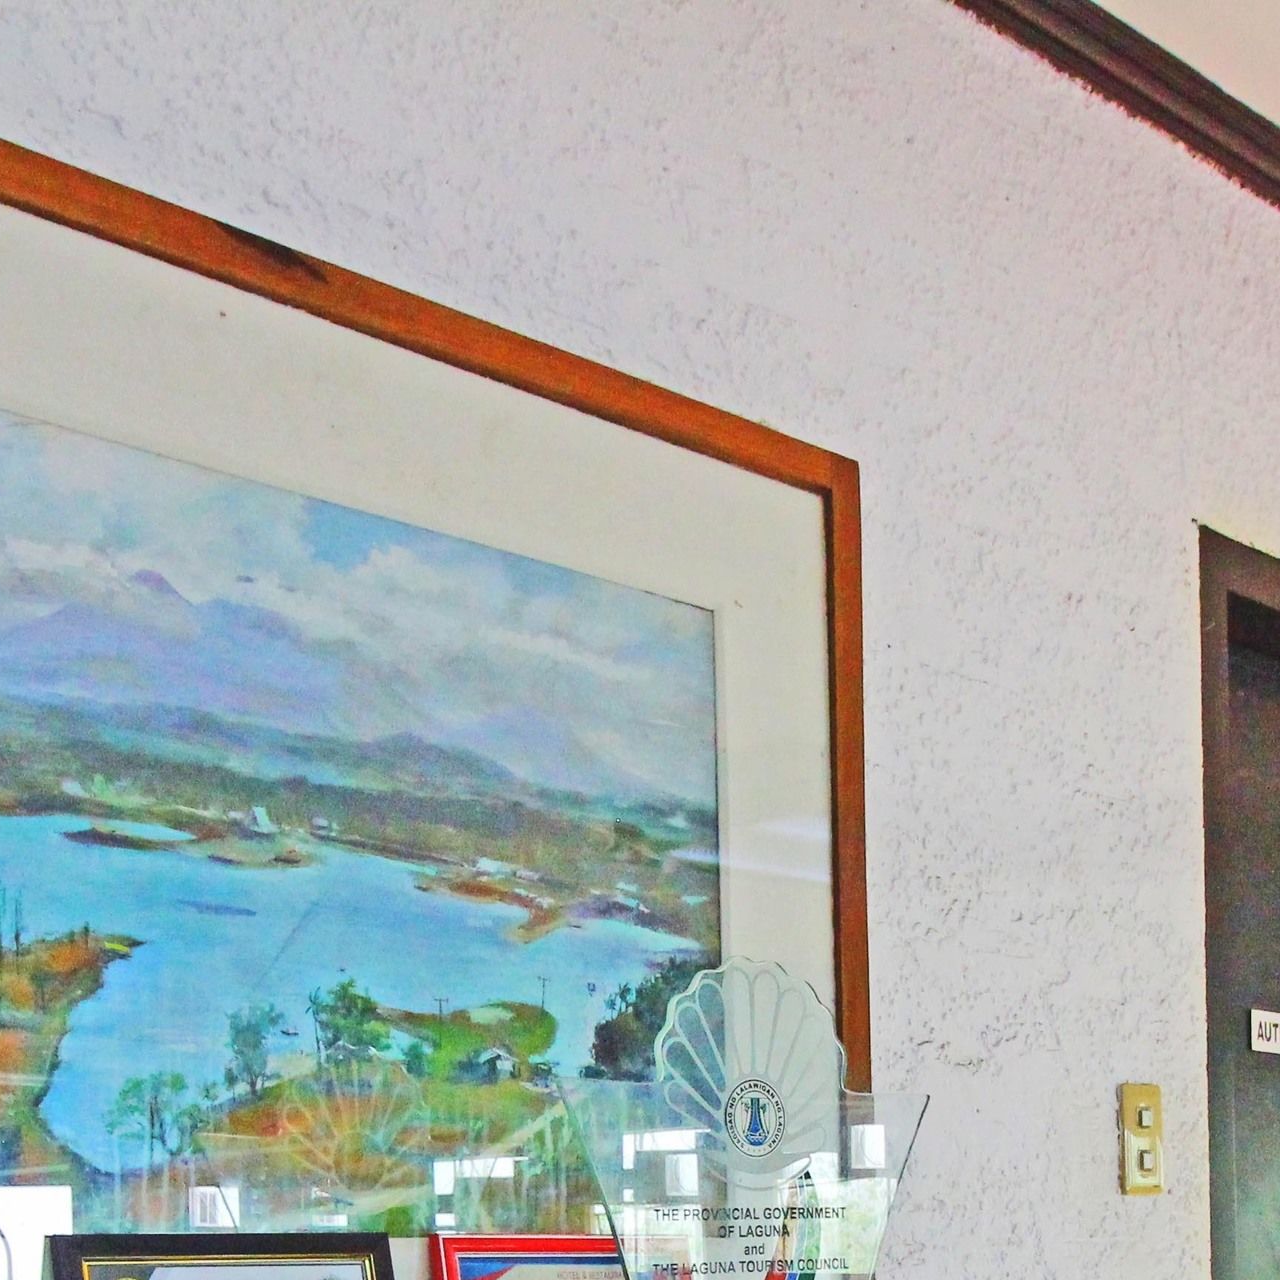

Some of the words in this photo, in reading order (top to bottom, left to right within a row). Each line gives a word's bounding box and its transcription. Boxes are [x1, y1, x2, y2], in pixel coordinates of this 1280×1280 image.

[736, 1083, 776, 1100] LALAWIGAN
[654, 1209, 679, 1221] THE
[683, 1208, 760, 1222] PROVINCIAL
[763, 1206, 846, 1220] GOVERNMENT
[718, 1225, 735, 1238] OF
[738, 1224, 790, 1238] LAGUNA
[744, 1243, 765, 1255] and
[653, 1263, 678, 1276] THE
[682, 1261, 736, 1275] LAGUNA
[739, 1259, 794, 1273] TOURISM
[797, 1258, 849, 1272] COUNCIL
